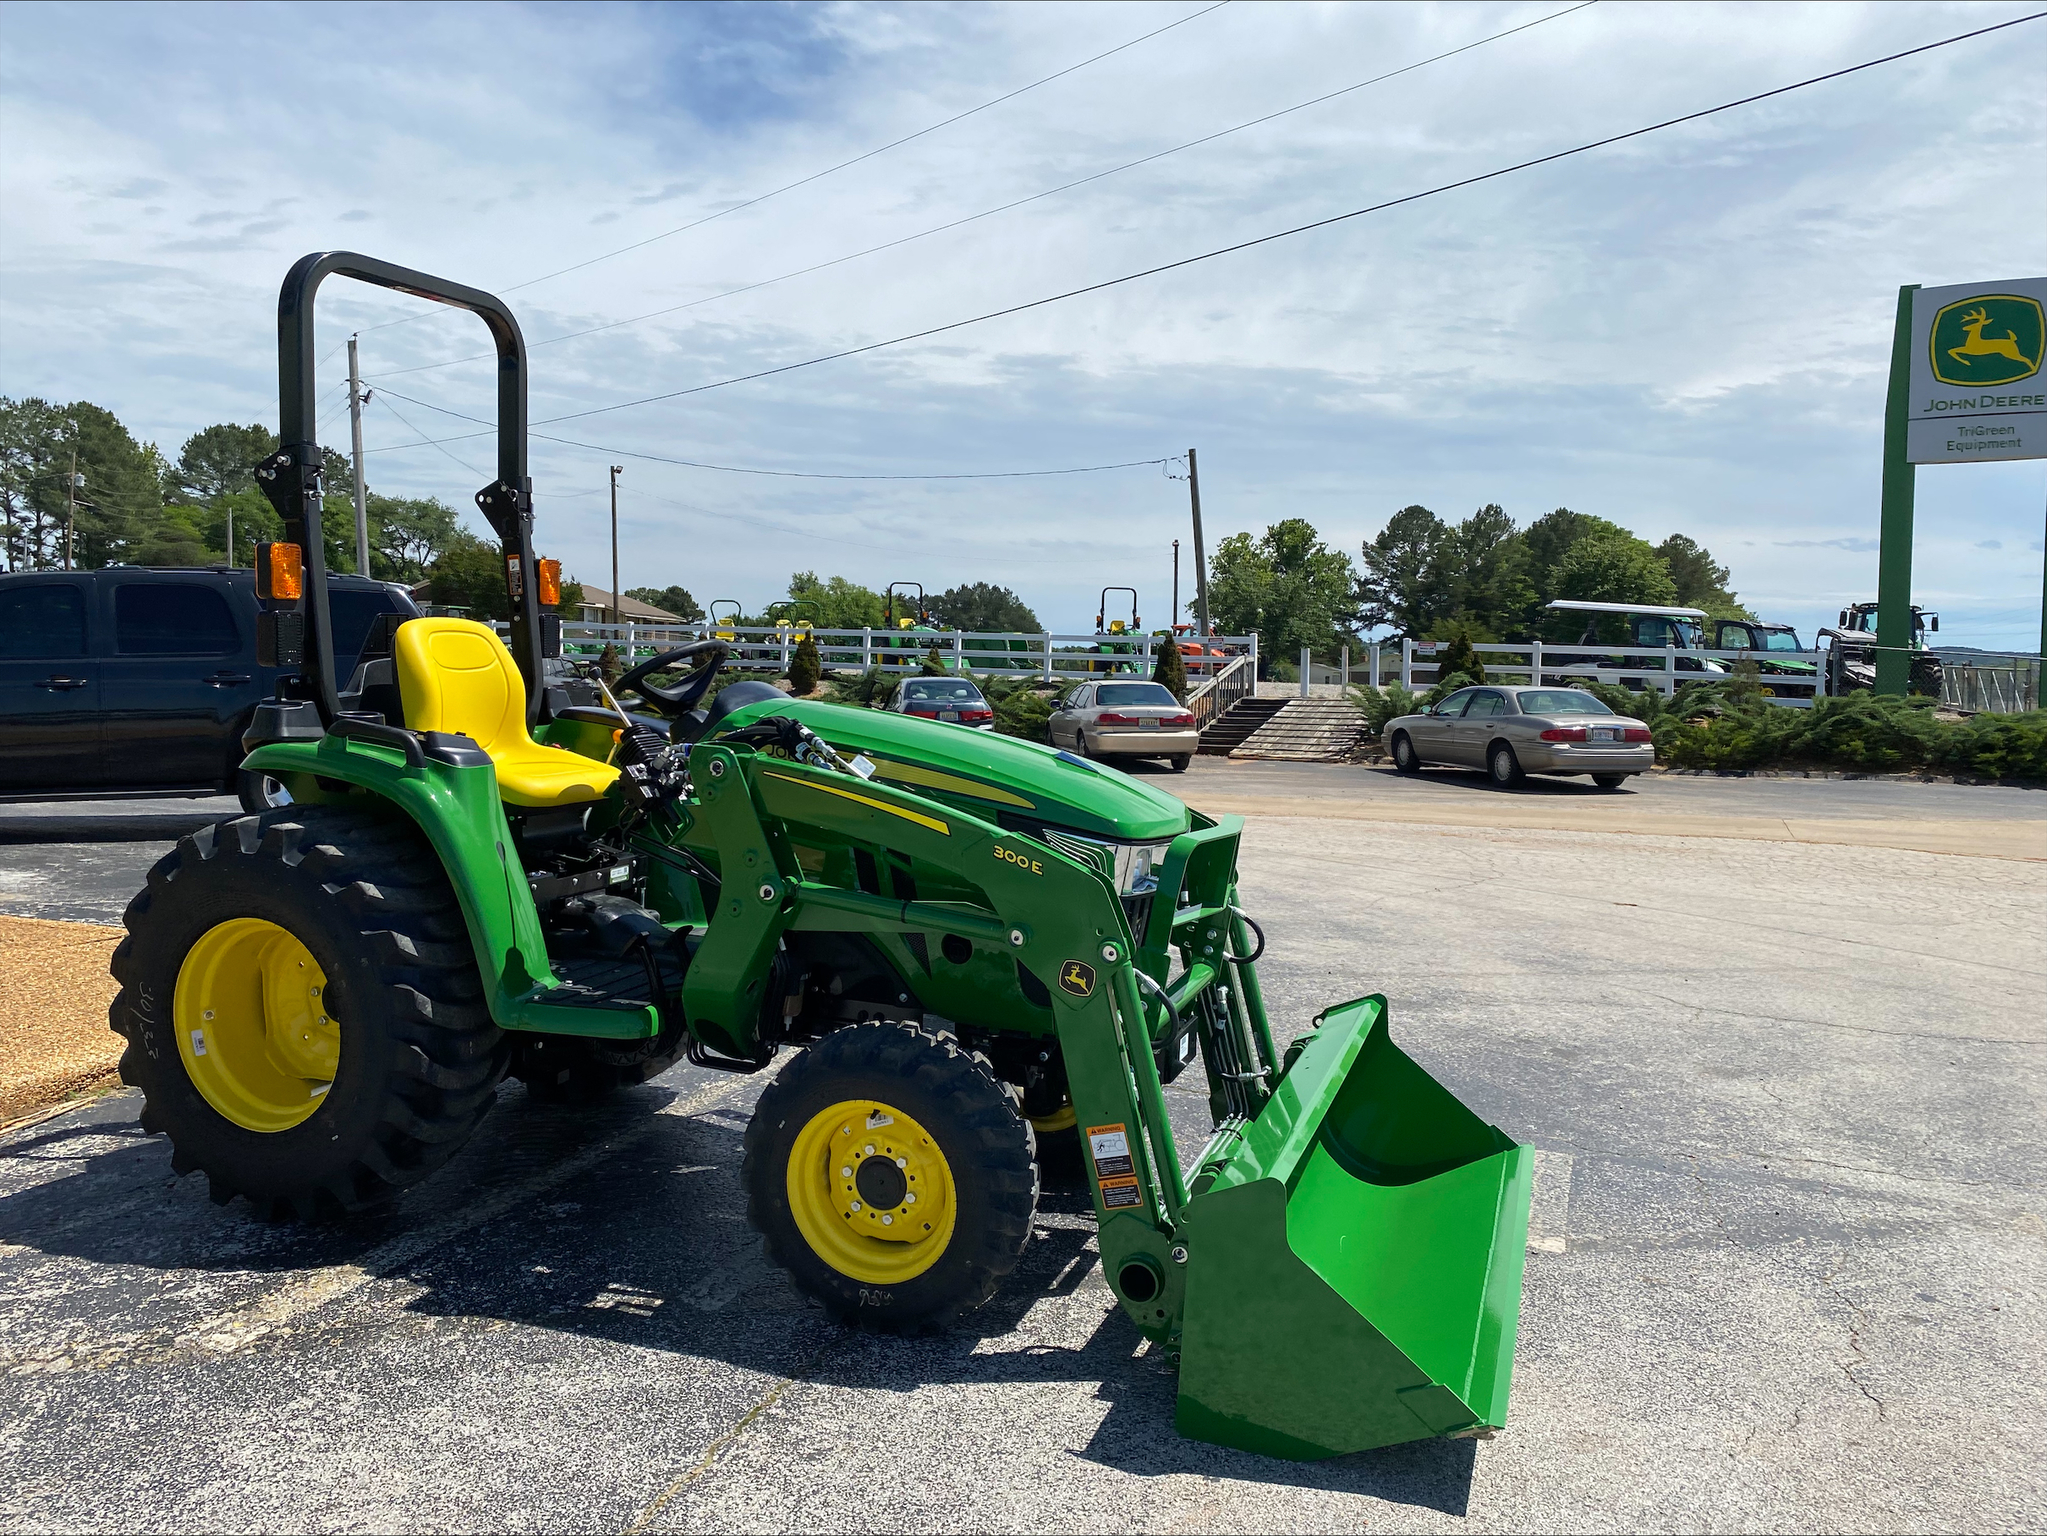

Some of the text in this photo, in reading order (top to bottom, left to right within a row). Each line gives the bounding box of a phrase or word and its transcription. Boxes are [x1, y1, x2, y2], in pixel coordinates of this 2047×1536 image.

[1923, 394, 2046, 412] JOHN DEERE
[1957, 425, 2015, 438] TriGreen
[1946, 437, 2022, 452] Equipment
[993, 844, 1043, 875] 300 E
[1096, 1125, 1121, 1133] WARNING
[1109, 1179, 1134, 1187] WARNING
